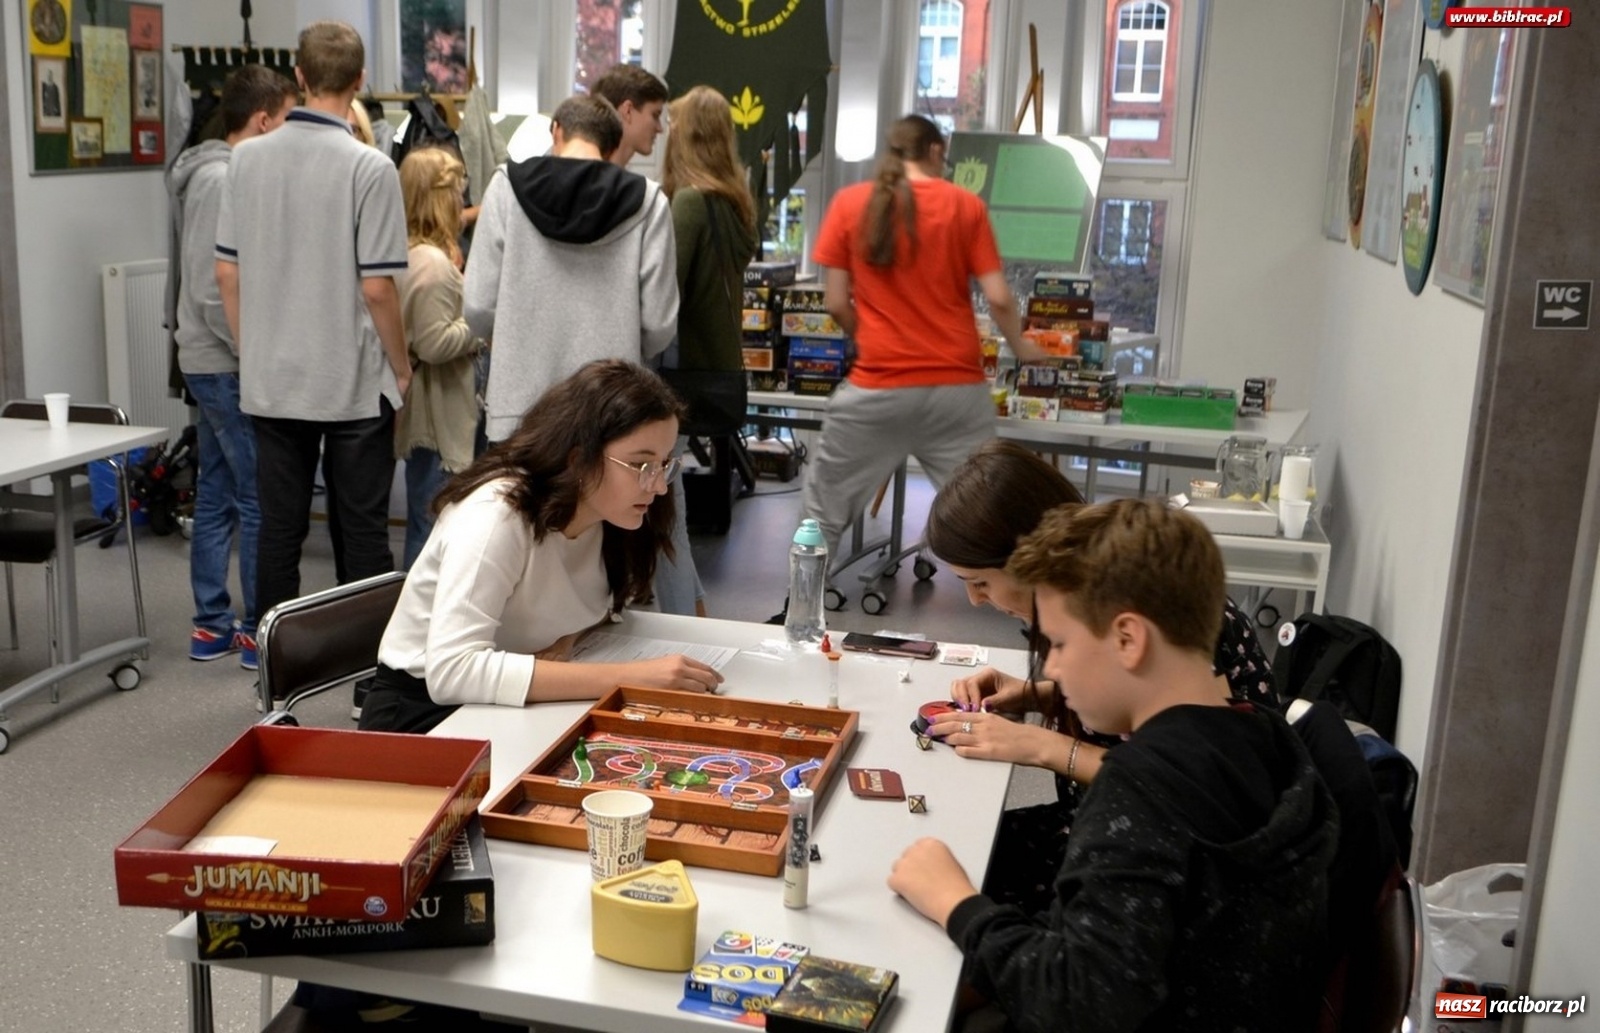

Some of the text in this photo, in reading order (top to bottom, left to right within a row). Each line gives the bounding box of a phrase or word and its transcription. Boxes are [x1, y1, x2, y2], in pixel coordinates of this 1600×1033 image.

[1544, 286, 1582, 303] WC
[184, 865, 320, 902] JUMANJI
[292, 921, 405, 940] ANKH-MORPORK
[692, 963, 787, 986] DOS
